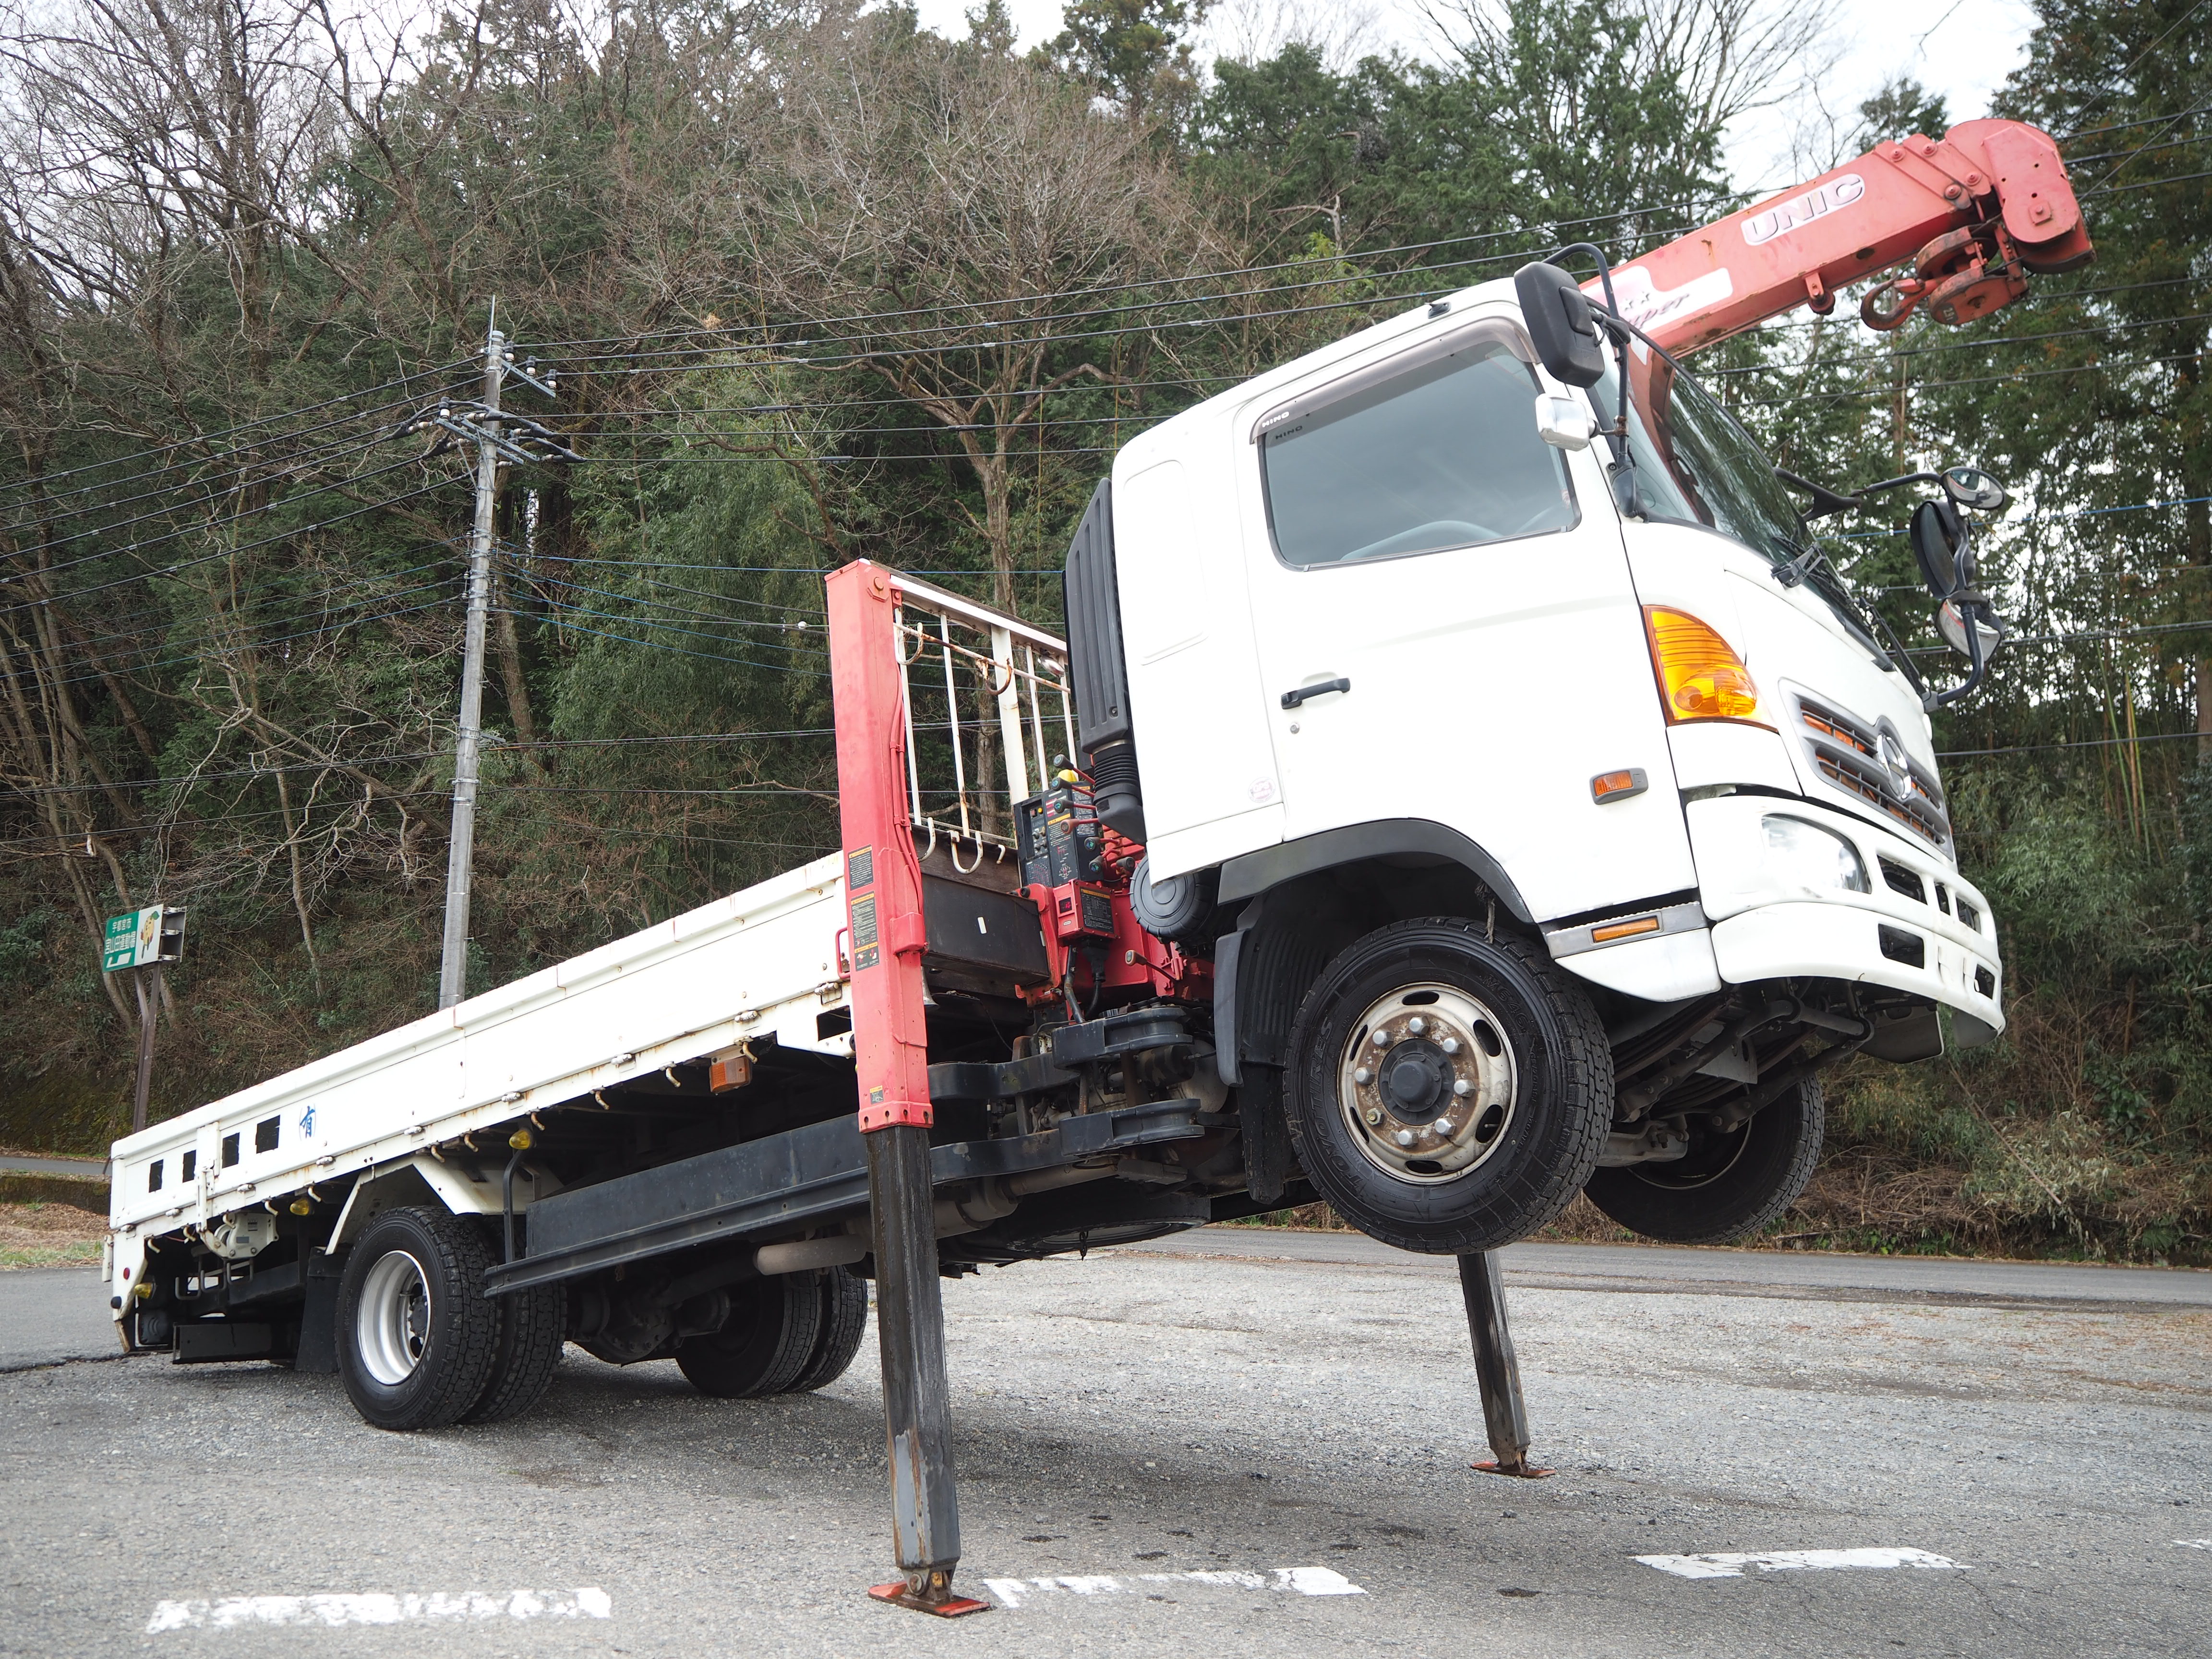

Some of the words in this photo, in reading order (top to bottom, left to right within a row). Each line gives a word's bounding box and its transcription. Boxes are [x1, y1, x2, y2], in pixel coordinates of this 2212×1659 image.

[1743, 174, 1863, 242] UNIC
[1262, 411, 1289, 428] HINO
[1275, 425, 1302, 439] HINO
[1482, 975, 1528, 1027] M646
[1310, 1015, 1334, 1111] TIRES
